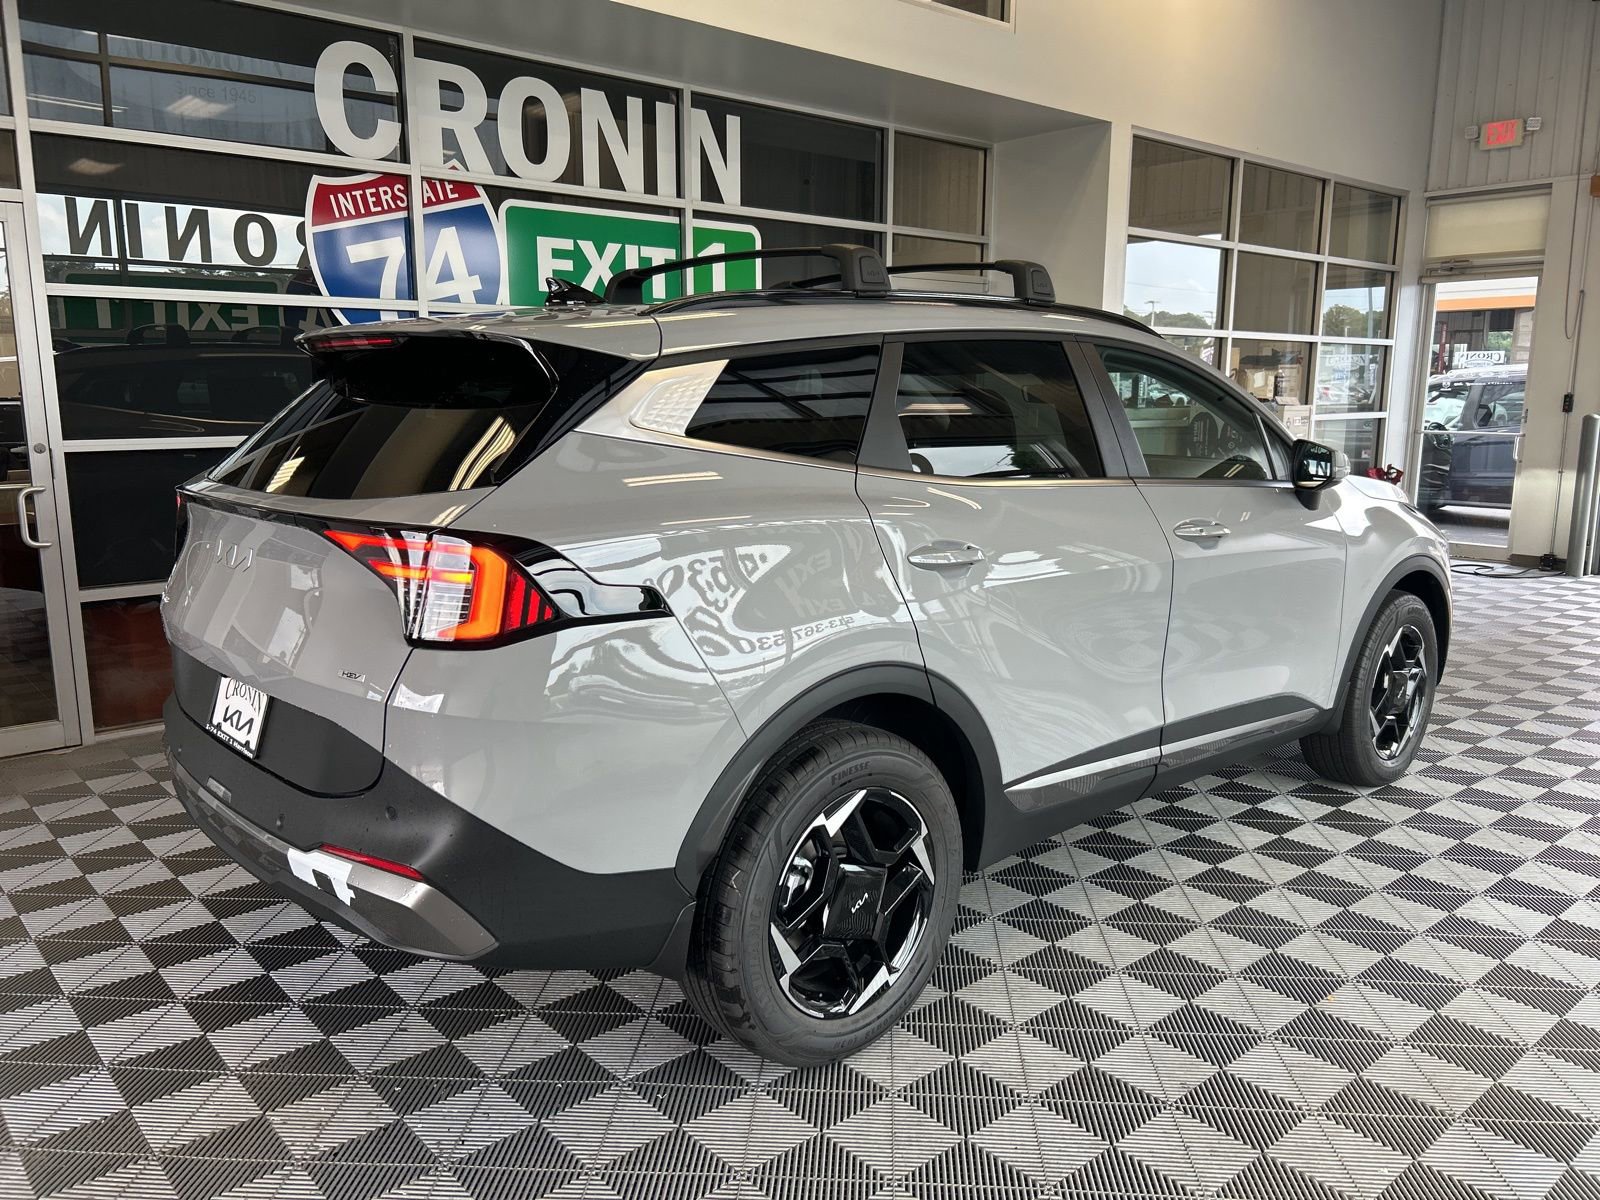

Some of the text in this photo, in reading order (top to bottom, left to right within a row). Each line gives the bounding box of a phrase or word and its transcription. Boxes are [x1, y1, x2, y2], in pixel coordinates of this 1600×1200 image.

[314, 41, 741, 206] CRONIN
[329, 179, 459, 218] INTERSATE
[346, 226, 482, 320] 74
[536, 236, 726, 301] EXIT 1
[342, 671, 362, 680] HEV
[226, 679, 265, 716] CRONIN
[223, 705, 254, 736] KIA
[217, 731, 230, 742] EXIT
[233, 742, 254, 759] Harrison
[831, 761, 872, 786] FINESSE
